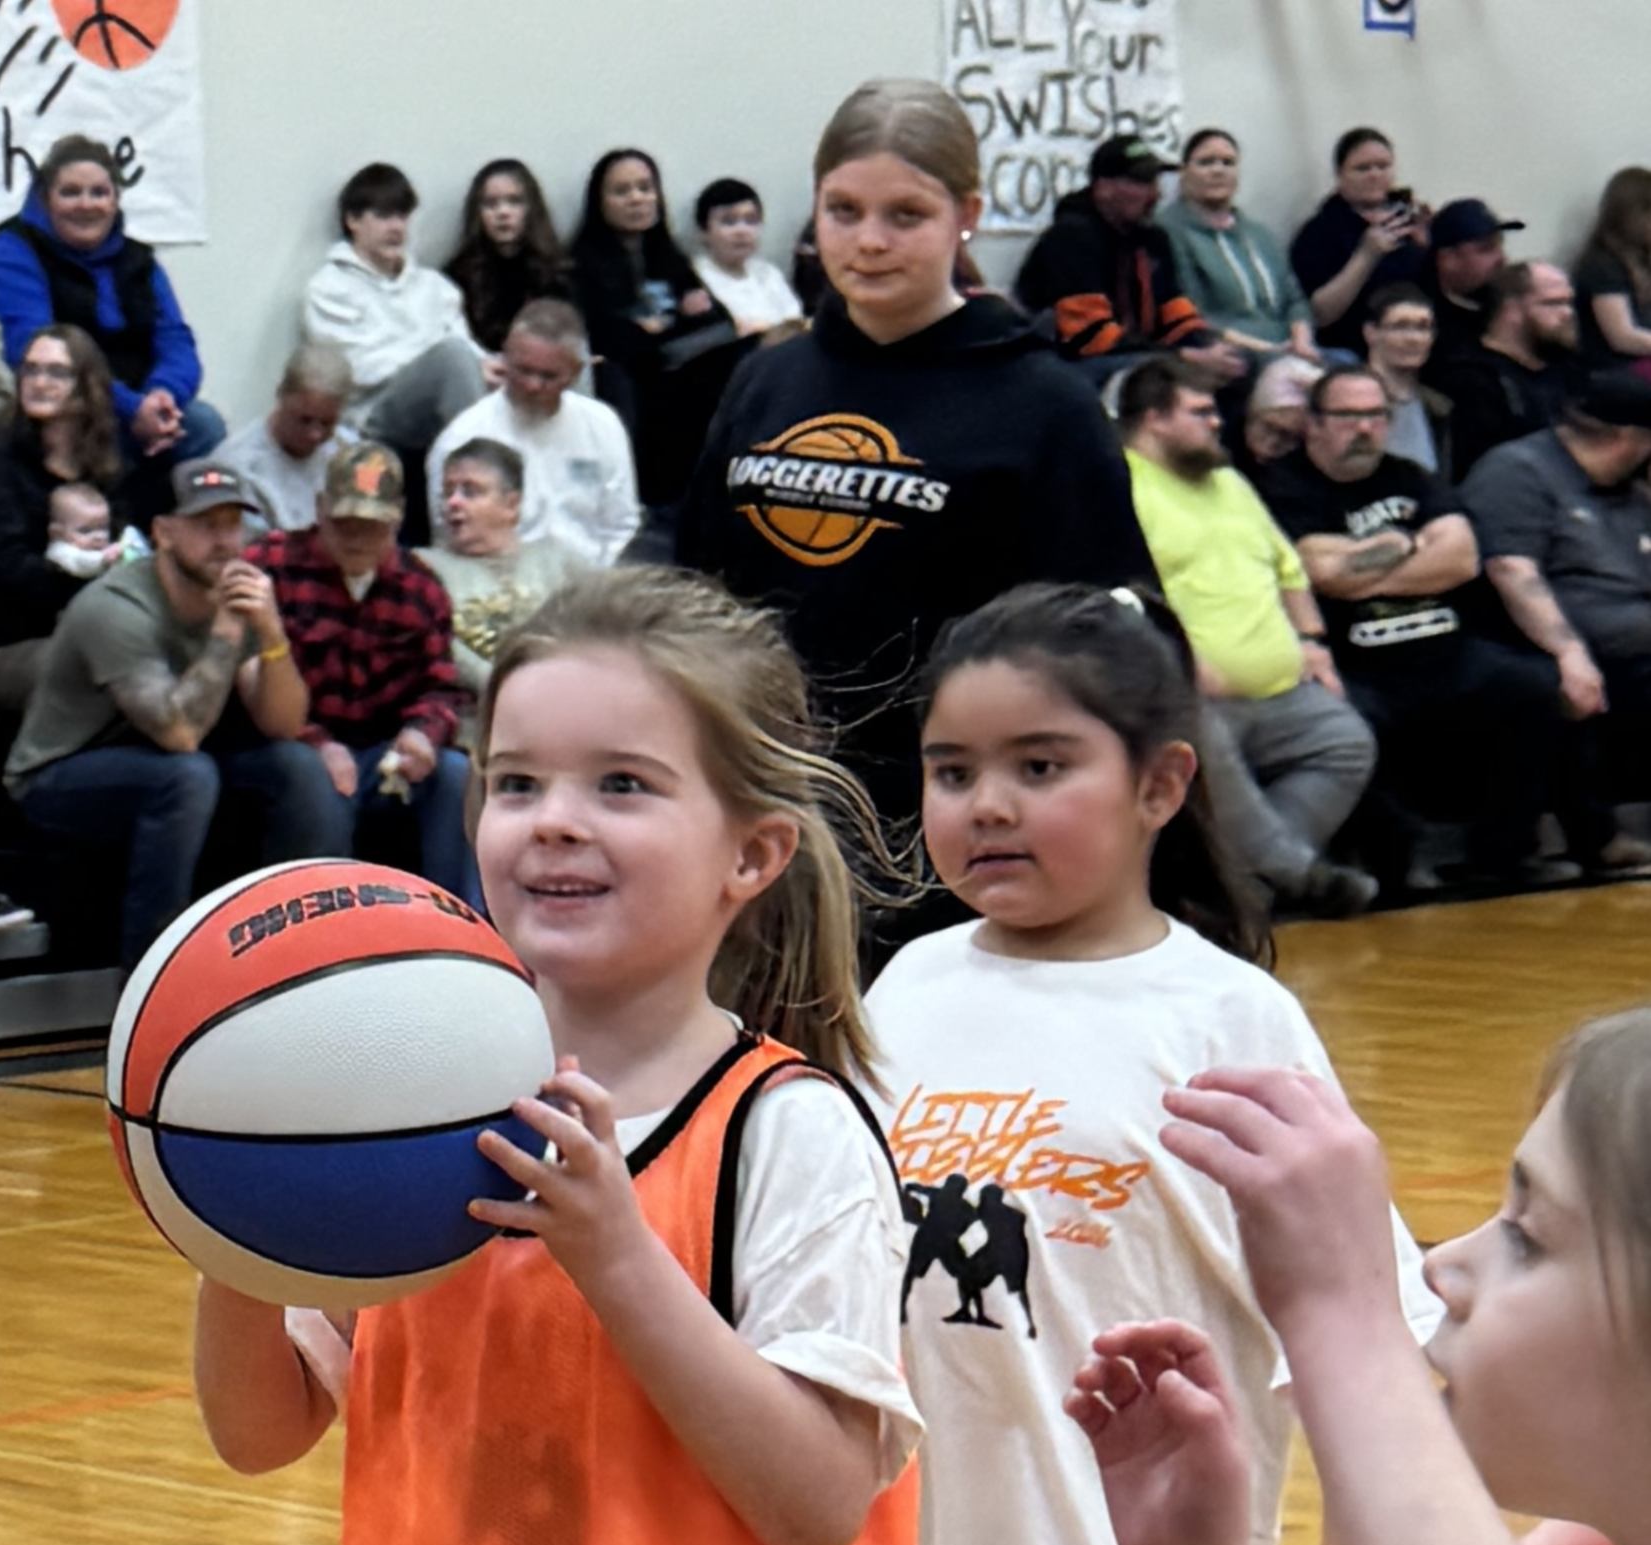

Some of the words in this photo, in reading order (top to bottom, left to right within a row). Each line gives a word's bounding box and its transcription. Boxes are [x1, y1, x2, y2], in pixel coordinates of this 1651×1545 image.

[952, 0, 1055, 56] ALL
[1, 105, 145, 192] he
[889, 1084, 1067, 1146] LITTLE
